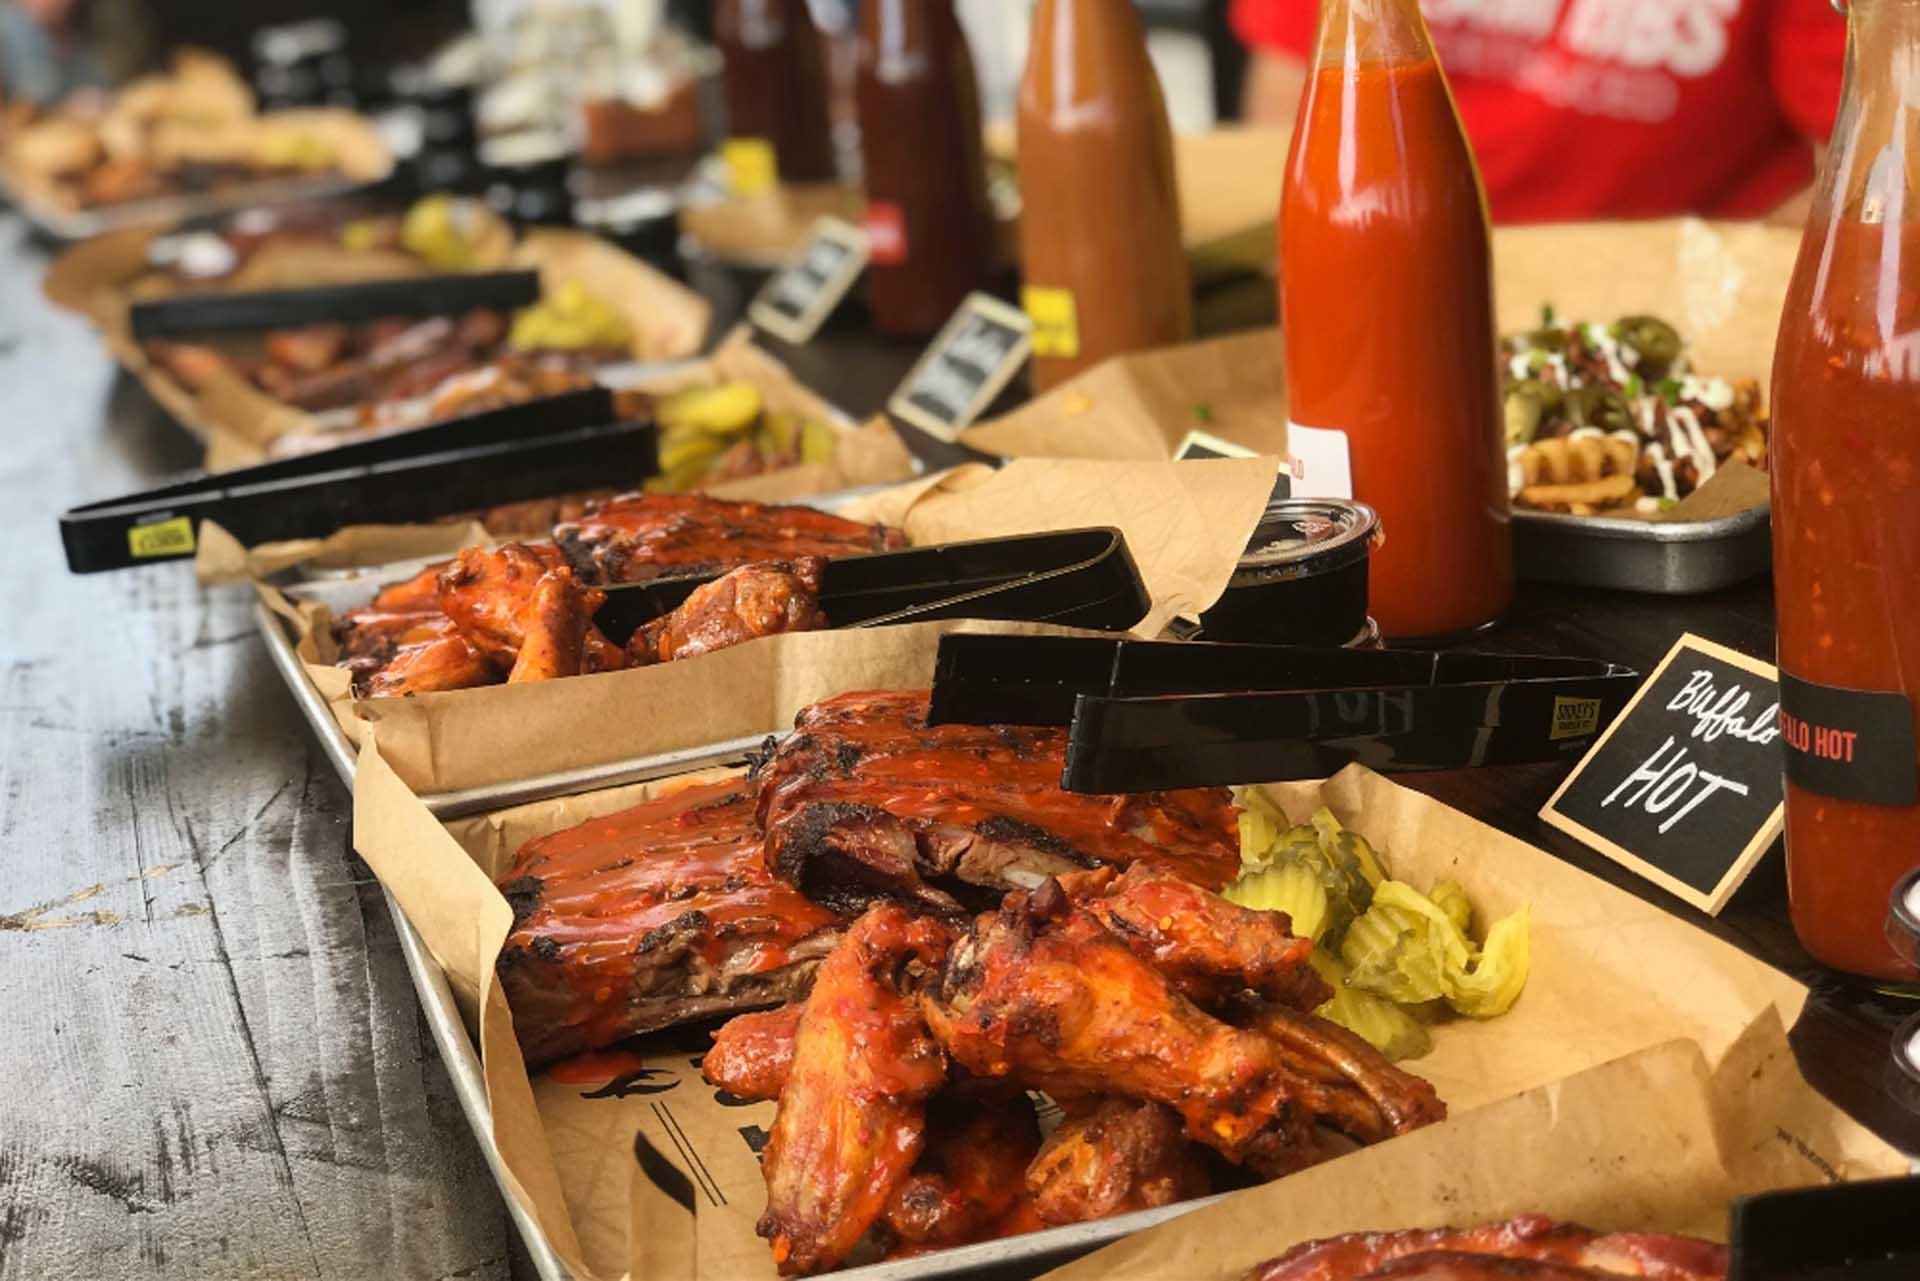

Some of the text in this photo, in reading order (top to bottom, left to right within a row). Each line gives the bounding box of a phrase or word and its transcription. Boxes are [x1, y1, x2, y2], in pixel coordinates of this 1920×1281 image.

[1666, 669, 1780, 744] Buffalo
[1815, 725, 1857, 763] HOT
[1601, 735, 1748, 834] HOT
